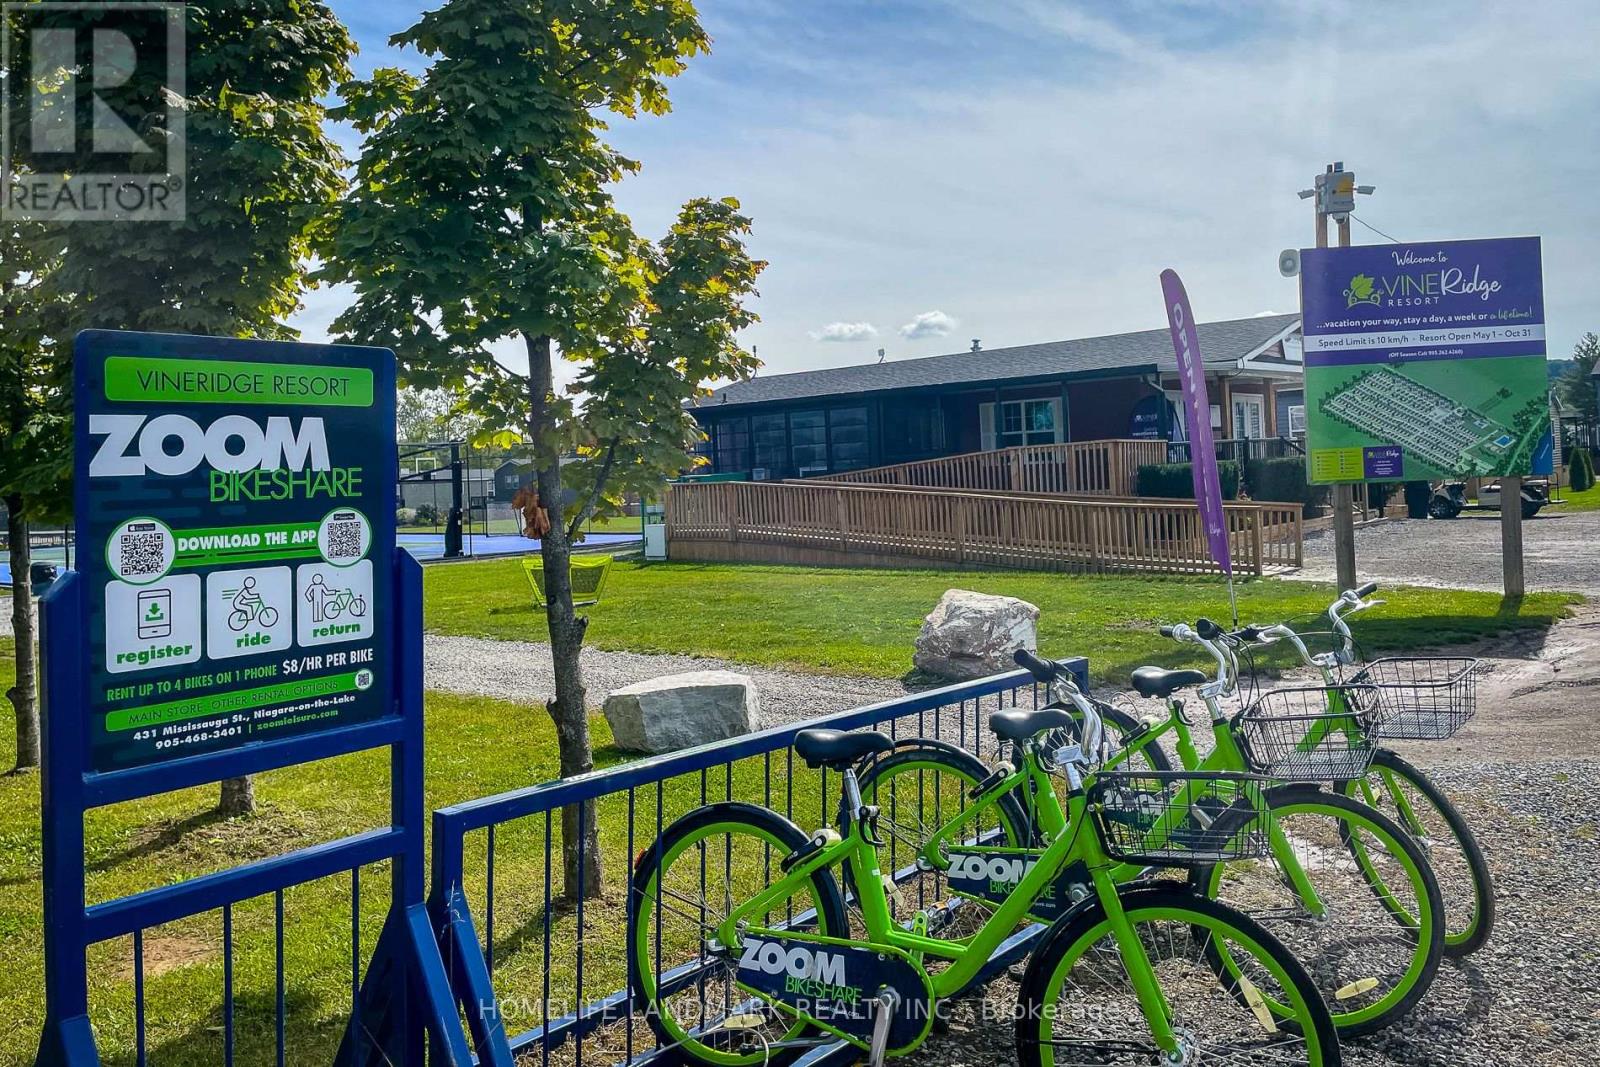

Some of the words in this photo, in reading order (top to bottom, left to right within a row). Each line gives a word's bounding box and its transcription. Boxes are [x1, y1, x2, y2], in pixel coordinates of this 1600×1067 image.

[1391, 249, 1436, 266] Welcome
[1437, 251, 1448, 263] to
[1388, 296, 1439, 307] RESORT
[1362, 319, 1381, 328] your
[1382, 318, 1402, 326] way,
[1403, 316, 1421, 325] stay
[1428, 314, 1447, 324] day,
[1454, 313, 1477, 322] week
[1478, 313, 1488, 321] or
[1318, 338, 1344, 349] Speed
[1345, 337, 1367, 346] Limit
[1368, 337, 1376, 345] is
[1377, 336, 1386, 345] 10
[1387, 335, 1409, 346] km/h
[1419, 333, 1446, 342] Resort
[1447, 332, 1471, 342] Open
[1473, 331, 1491, 341] May
[1504, 328, 1520, 338] Oct
[1522, 328, 1532, 338] 31
[136, 369, 265, 395] VINERIDGE
[272, 374, 351, 398] RESORT
[88, 413, 331, 477] ZOOM
[209, 466, 363, 502] BIKESHARE
[178, 533, 260, 552] DOWNLOAD
[264, 532, 287, 546] THE
[291, 529, 317, 544] APP
[236, 631, 272, 648] ride
[312, 622, 361, 638] return
[116, 644, 193, 665] register
[107, 686, 136, 702] RENT
[138, 683, 154, 697] UP
[156, 680, 172, 694] TO
[174, 679, 182, 691] 4
[184, 674, 213, 690] BIKES
[216, 671, 232, 684] ON
[244, 664, 277, 680] PHONE
[282, 656, 322, 675] $8/HR
[326, 652, 347, 668] PER
[349, 648, 374, 664] BIKE
[128, 709, 162, 725] MAIN
[167, 703, 202, 718] STORE
[211, 695, 248, 710] OTHER
[252, 685, 289, 703] RENTAL
[293, 681, 338, 697] OPTIONS
[133, 729, 157, 741] 431
[162, 716, 229, 736] Mississauga
[253, 694, 356, 719] Niagara-on-the-Lake
[155, 725, 242, 750] 905-468-3401
[738, 937, 846, 988] ZOOM
[785, 974, 863, 1007] BIKESHARE
